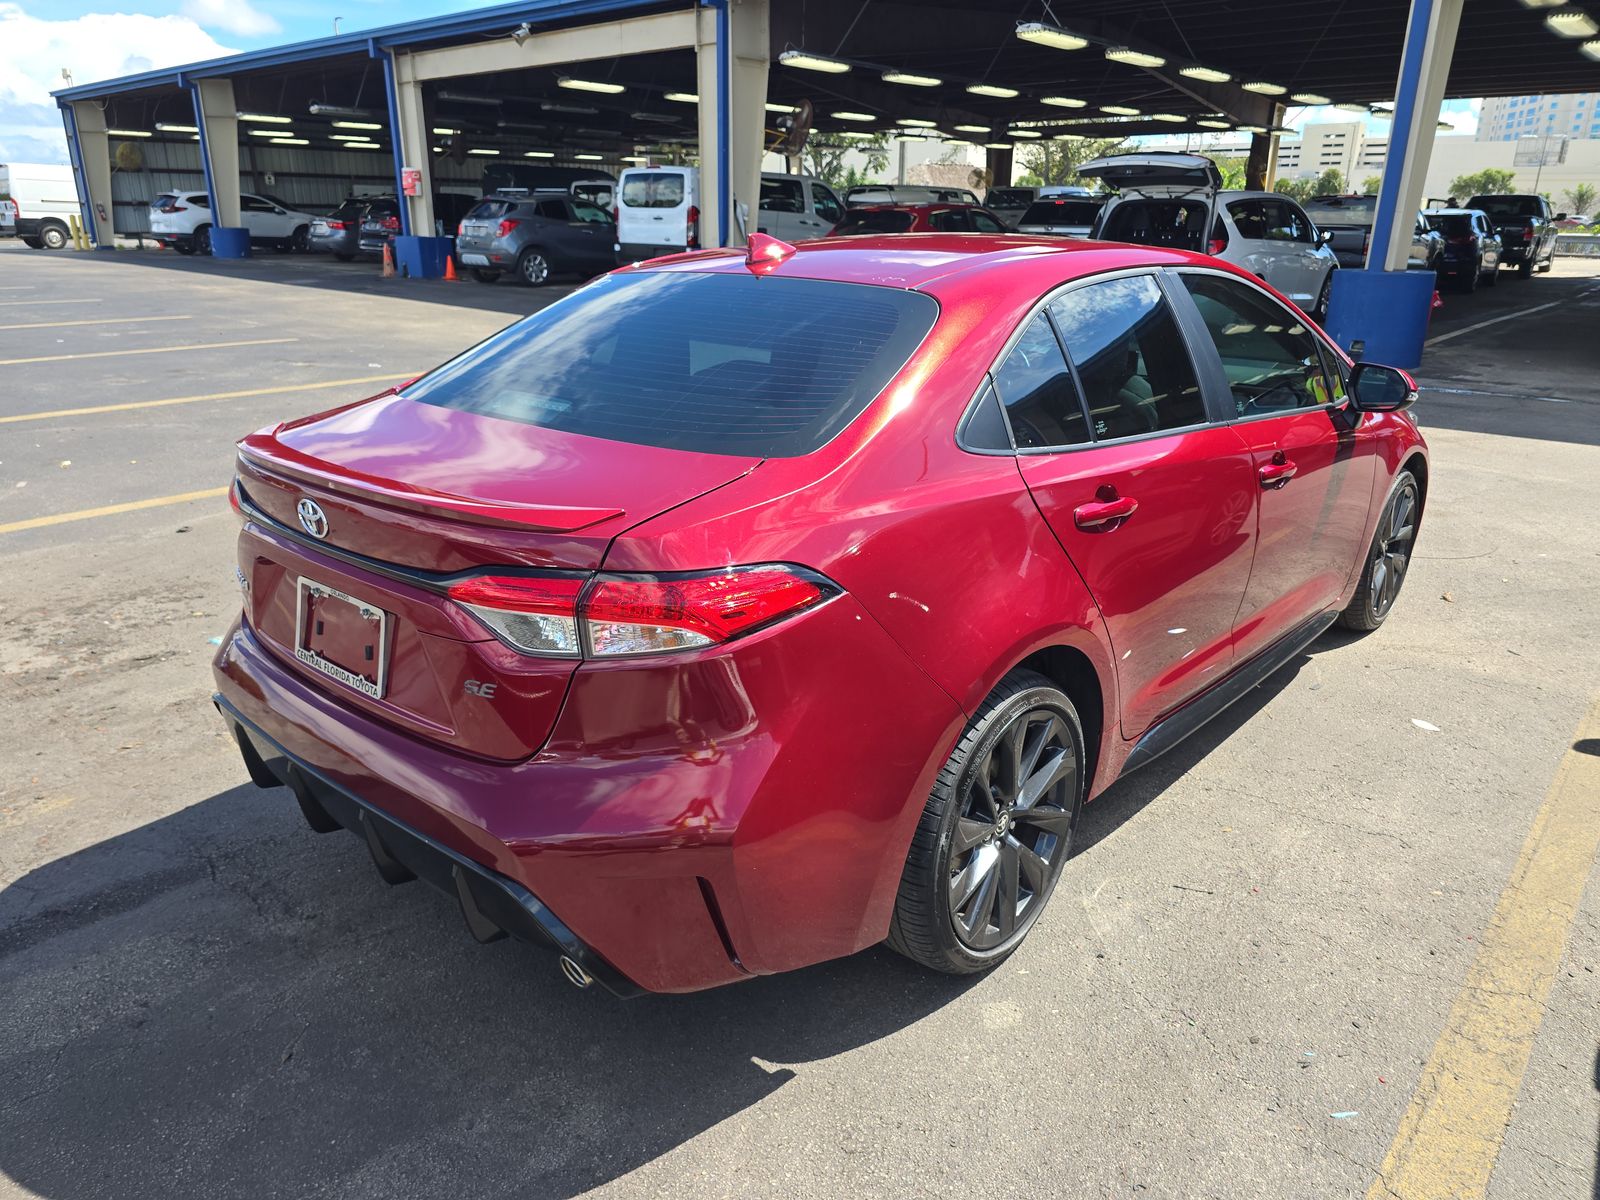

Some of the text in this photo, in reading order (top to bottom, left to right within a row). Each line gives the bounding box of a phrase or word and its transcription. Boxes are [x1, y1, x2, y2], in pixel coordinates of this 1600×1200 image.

[296, 649, 378, 697] CENTRAL FLORIDA TOYOTA
[464, 679, 497, 699] SE
